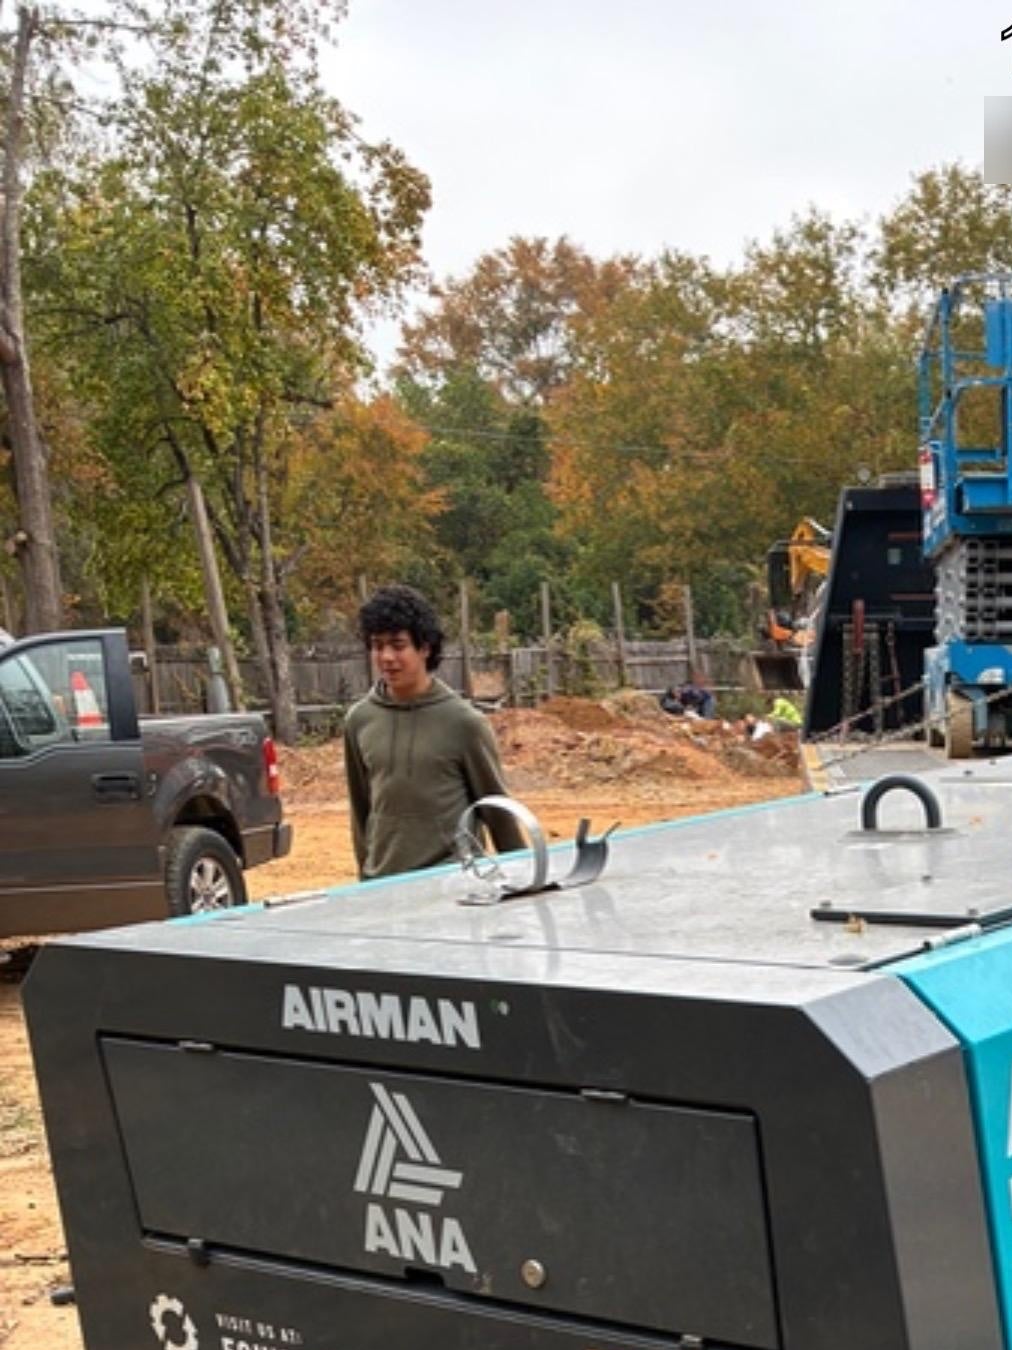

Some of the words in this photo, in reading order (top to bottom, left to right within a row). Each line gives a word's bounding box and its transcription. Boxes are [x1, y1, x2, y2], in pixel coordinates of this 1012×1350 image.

[282, 984, 481, 1048] AIRMAN
[365, 1202, 478, 1273] ANA
[215, 1313, 252, 1334] VISIT
